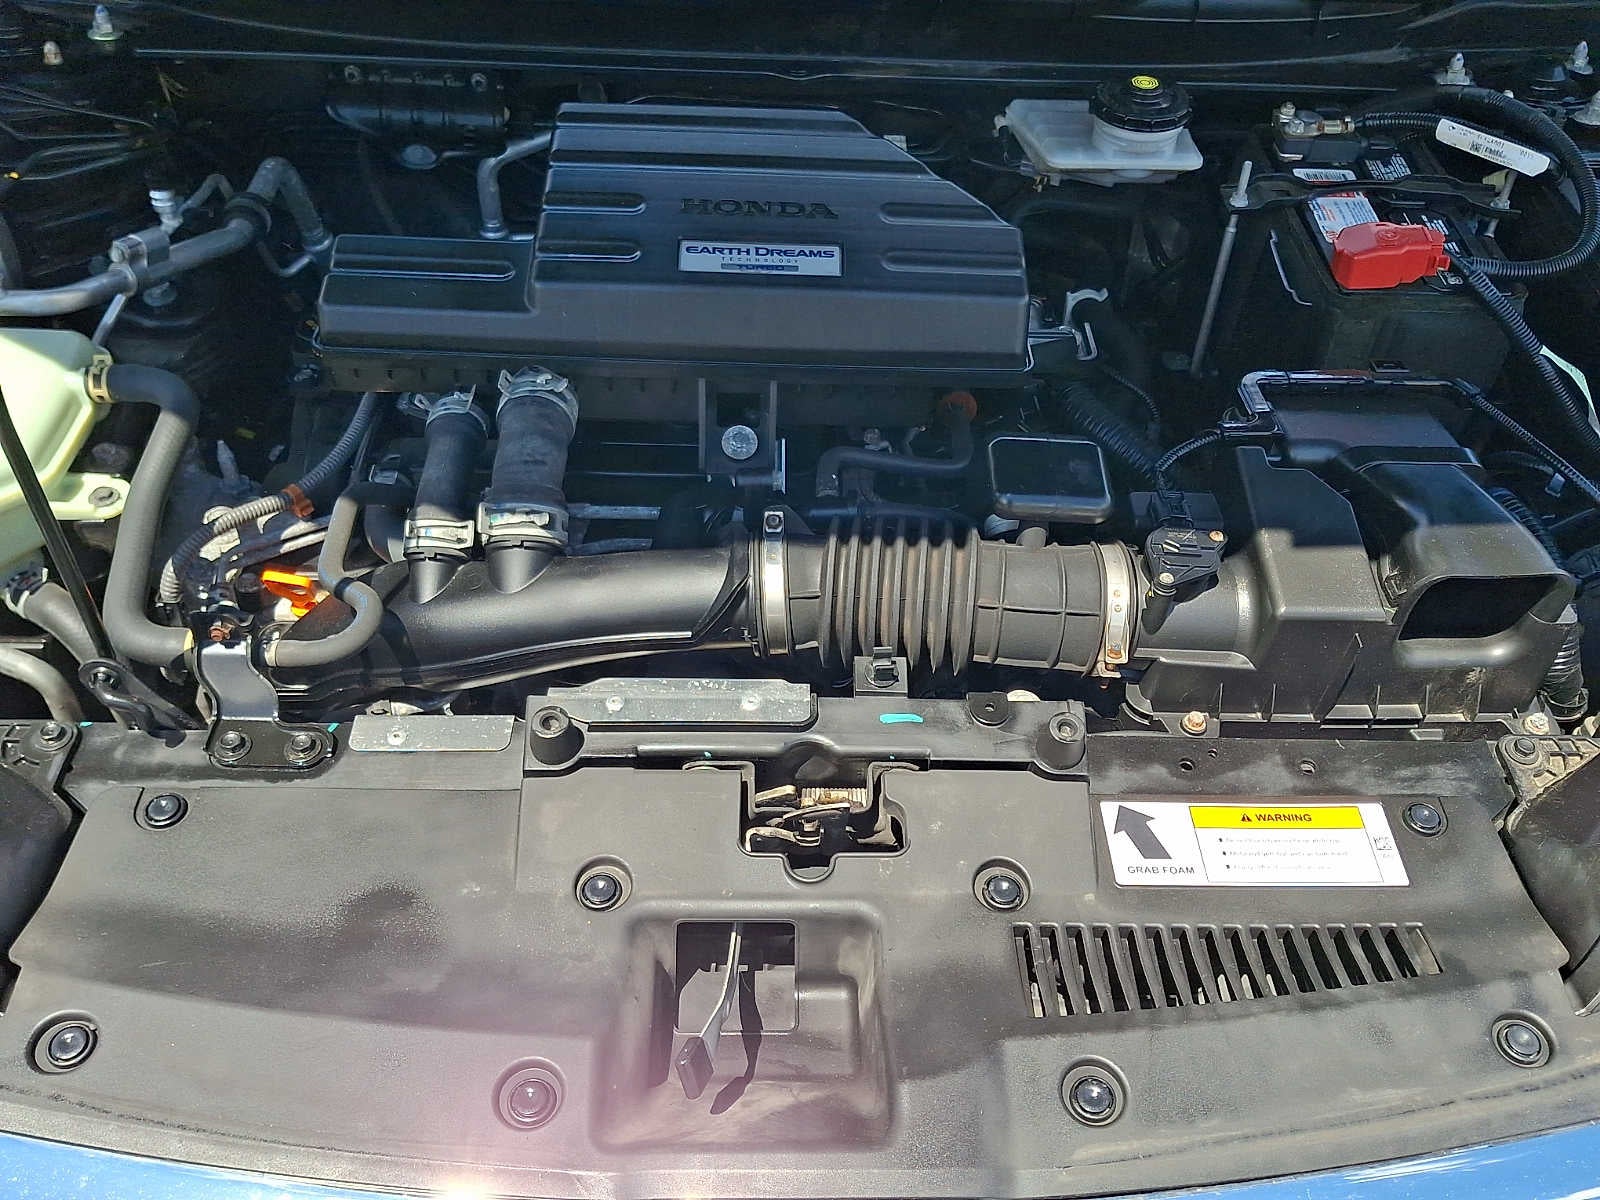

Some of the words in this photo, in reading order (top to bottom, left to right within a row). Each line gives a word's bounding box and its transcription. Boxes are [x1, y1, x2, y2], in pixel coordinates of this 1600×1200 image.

[680, 198, 839, 219] HONDA
[685, 245, 750, 256] EARTH
[754, 246, 835, 258] DREAMS
[721, 256, 799, 264] TECHNOLOGY
[1255, 813, 1312, 823] WARNING
[1127, 866, 1160, 875] GRAB
[1162, 866, 1196, 875] FOAM
